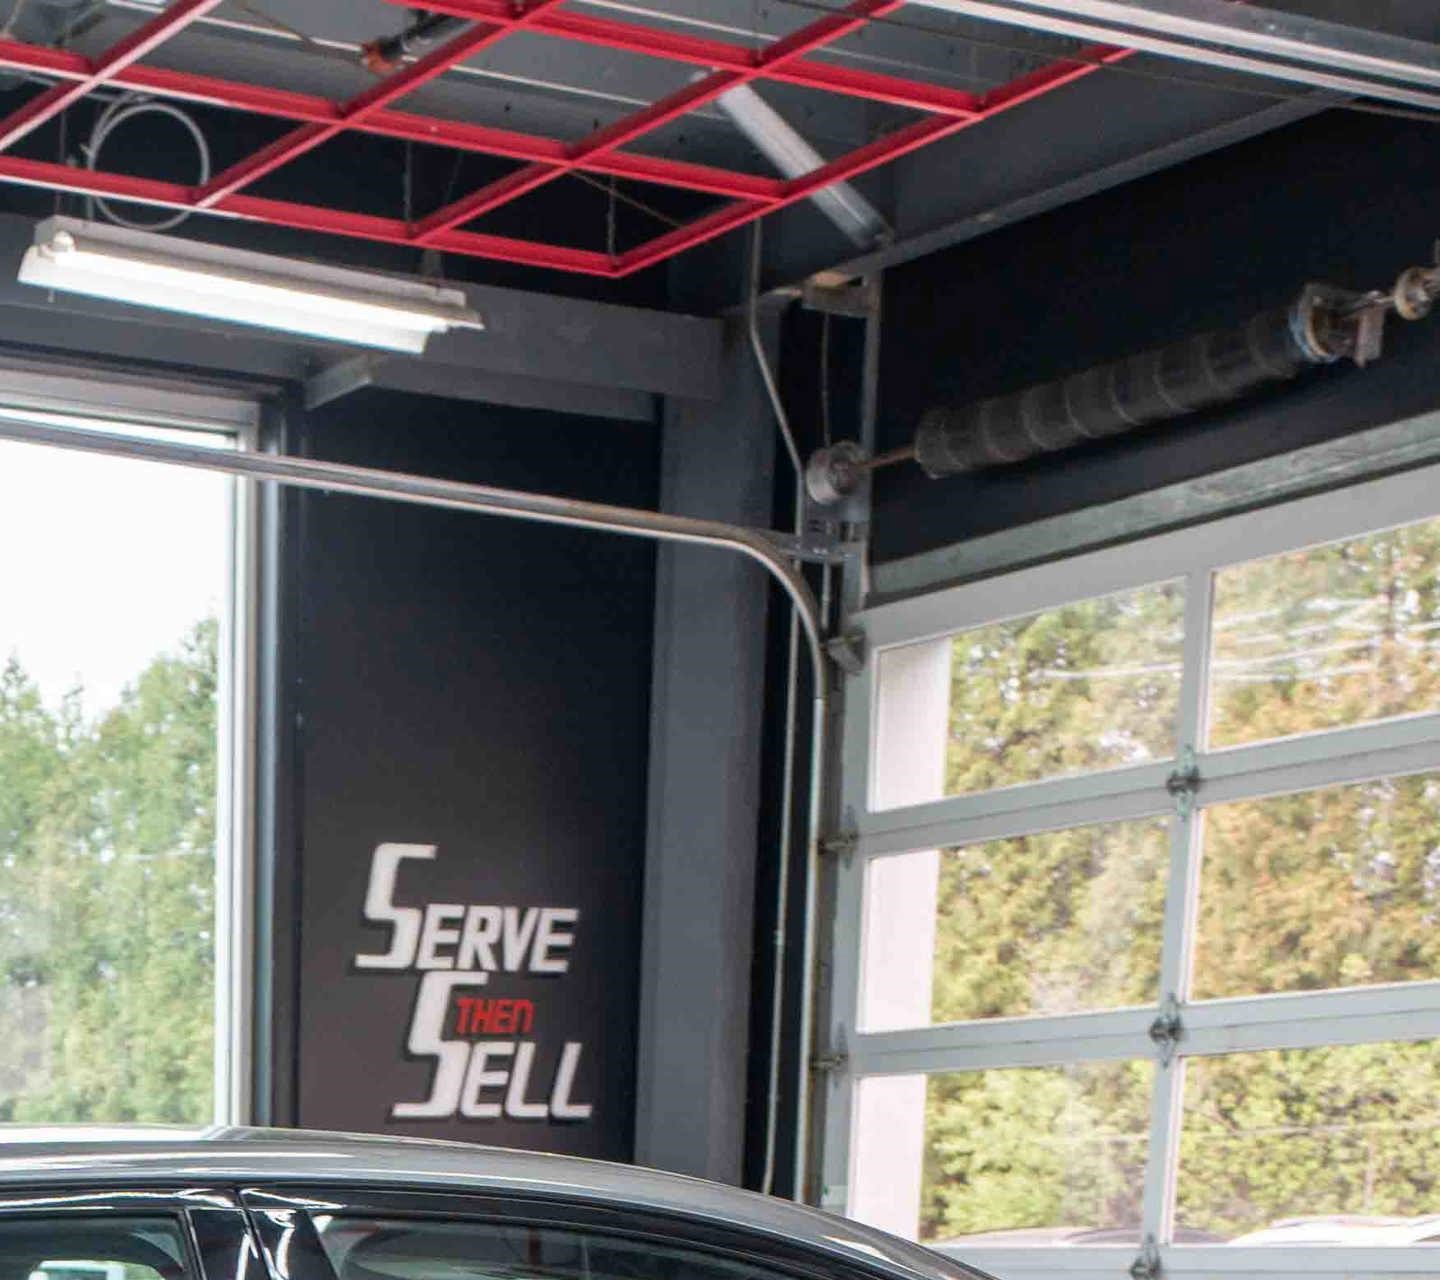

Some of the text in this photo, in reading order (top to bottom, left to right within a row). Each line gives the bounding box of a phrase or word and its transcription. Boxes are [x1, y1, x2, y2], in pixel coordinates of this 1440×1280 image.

[355, 842, 579, 973] SERVE
[392, 971, 592, 1118] SELL
[456, 998, 535, 1034] THEN
